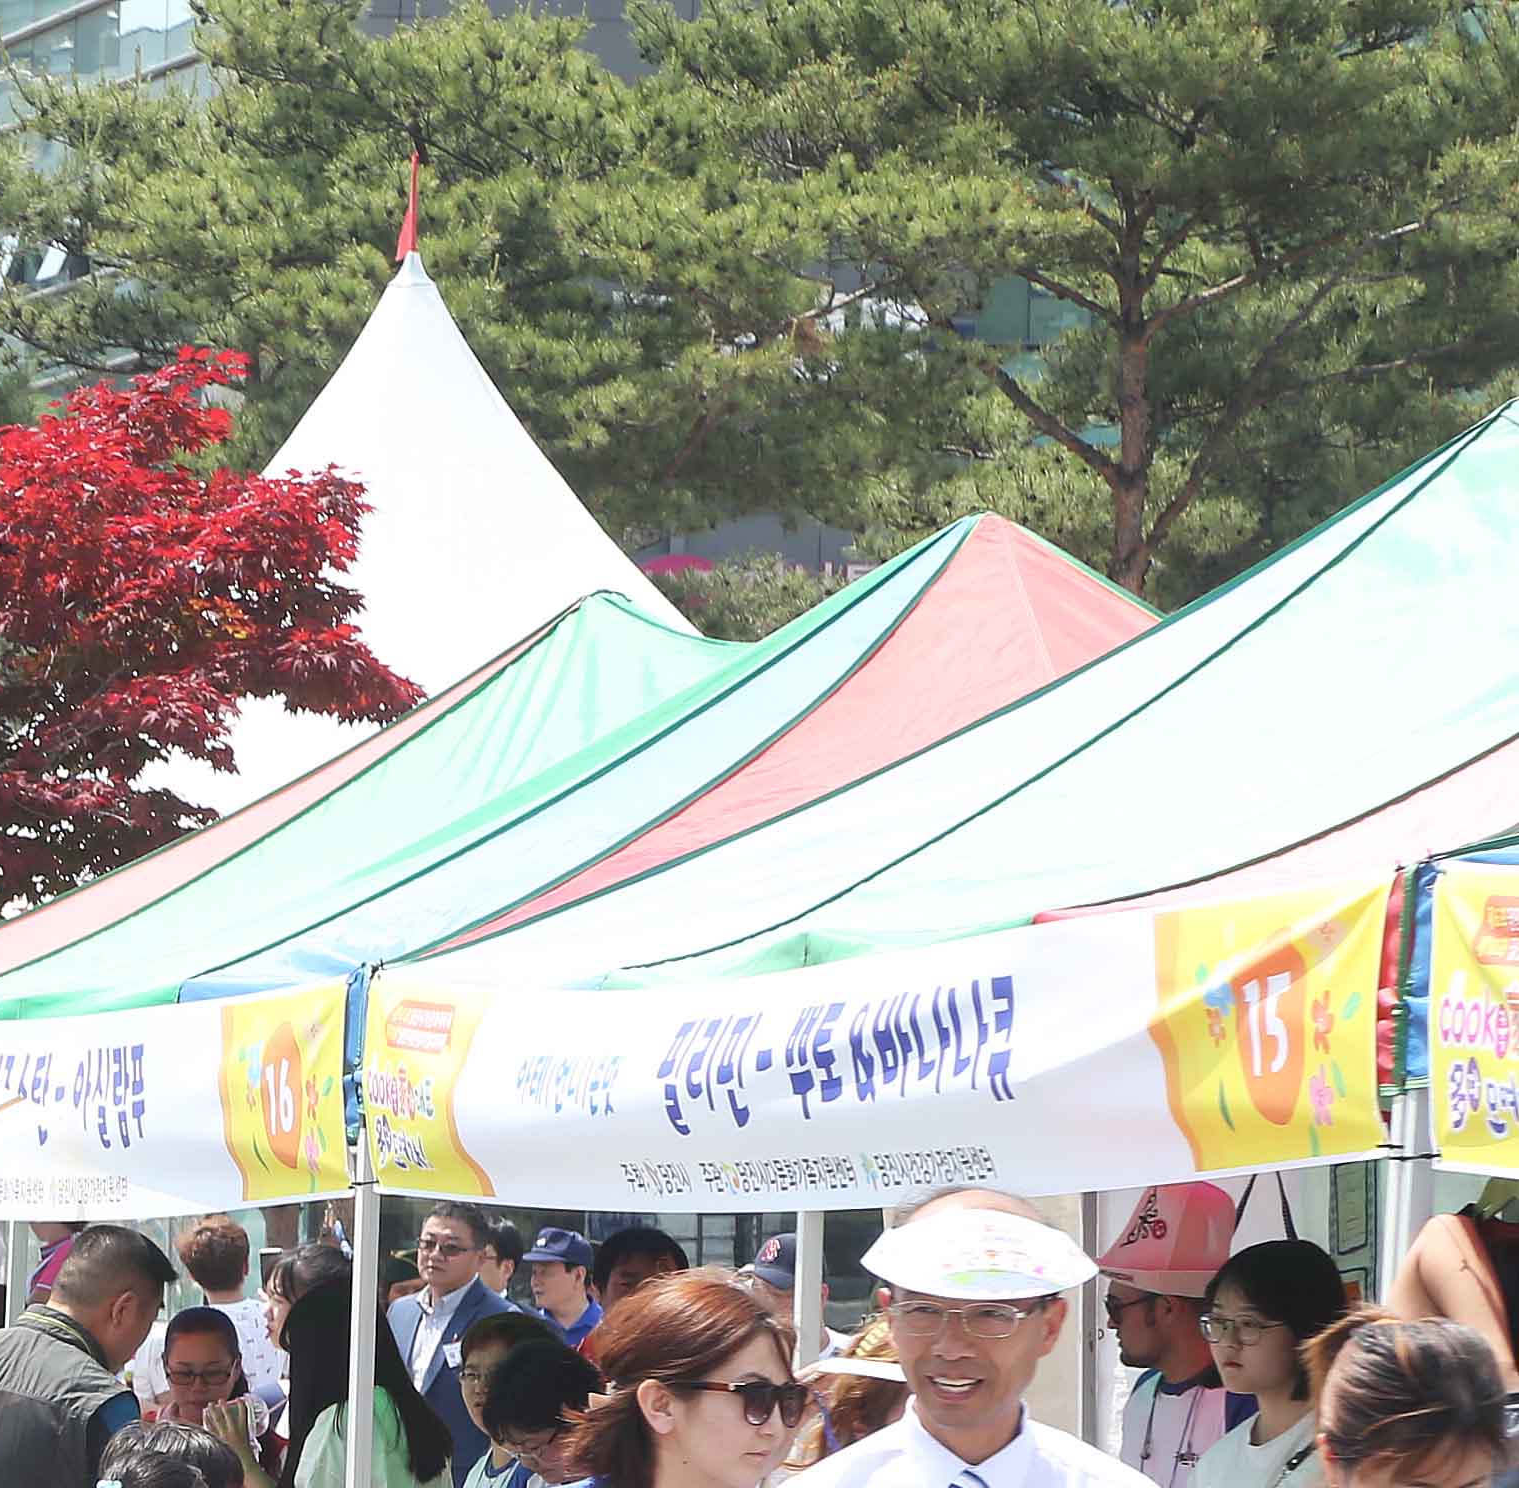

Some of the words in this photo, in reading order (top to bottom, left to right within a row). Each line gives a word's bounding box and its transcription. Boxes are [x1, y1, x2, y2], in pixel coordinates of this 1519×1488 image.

[1242, 971, 1291, 1077] 15
[264, 1057, 295, 1136] 16
[657, 1160, 694, 1195] 당진시
